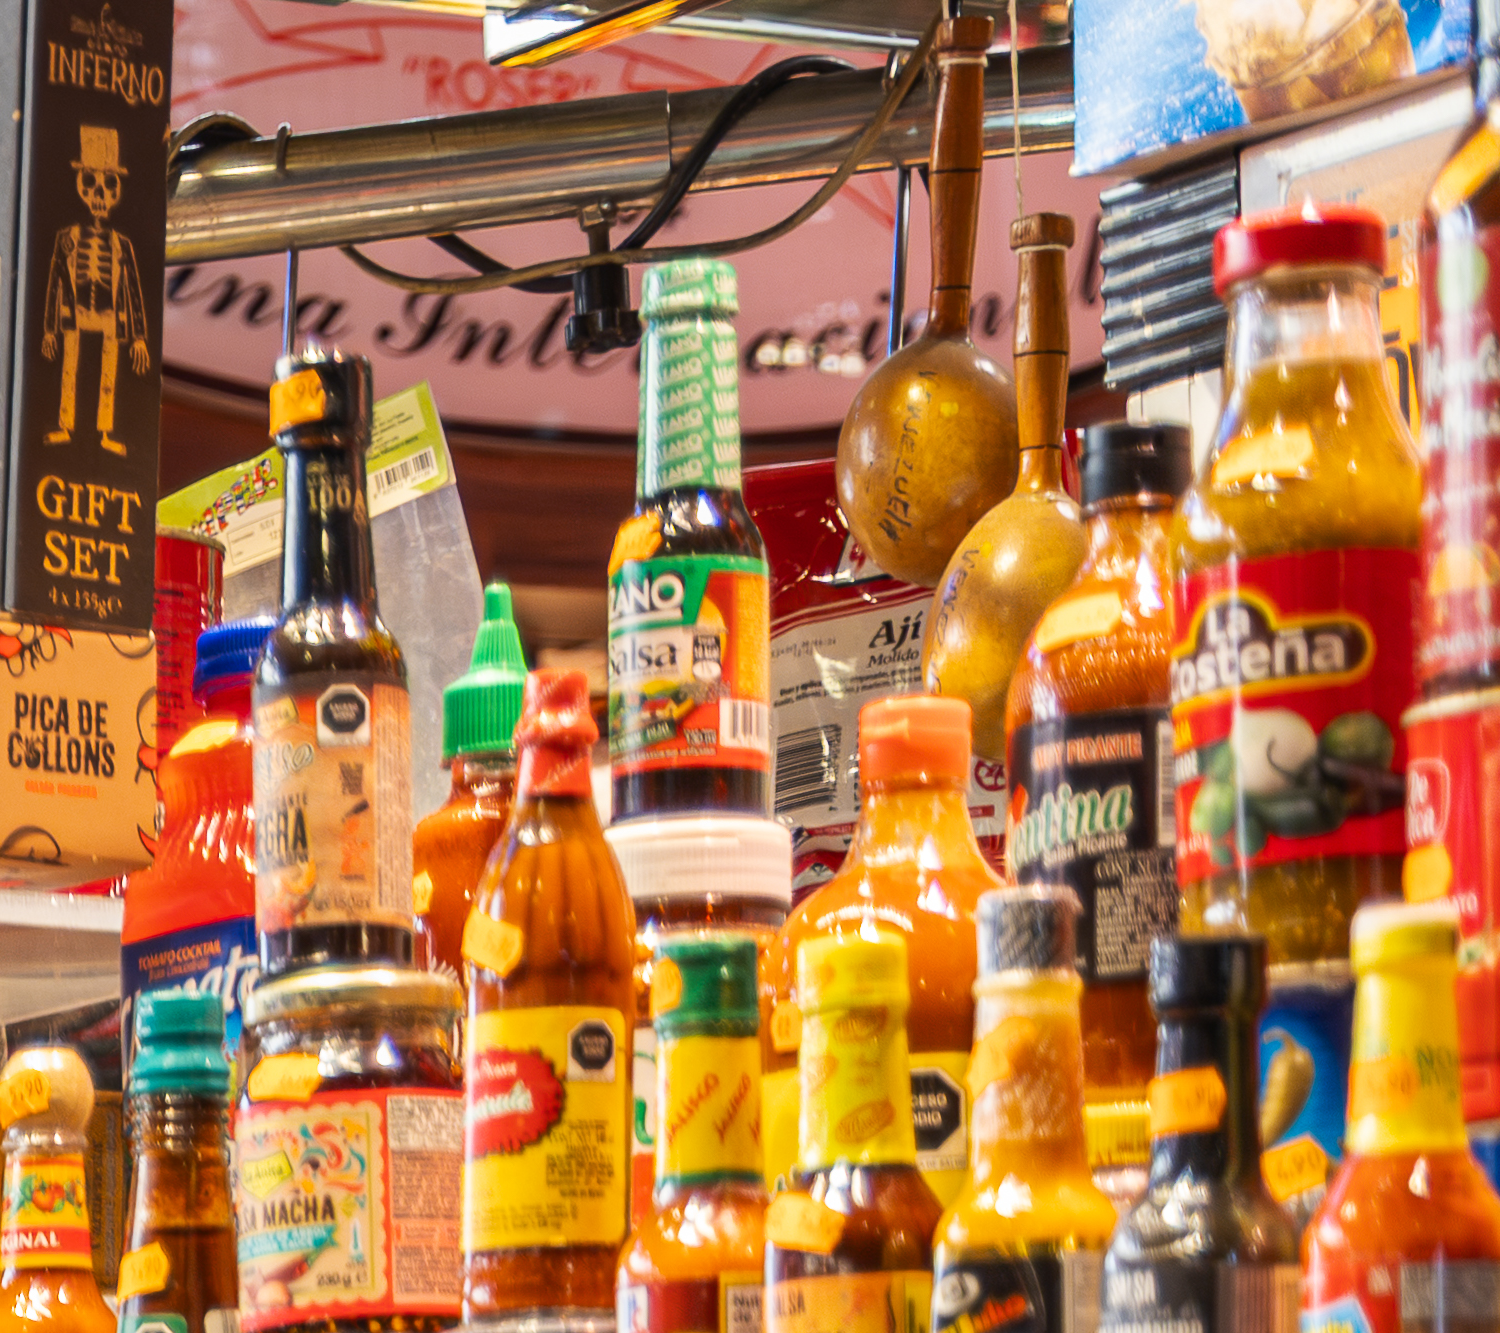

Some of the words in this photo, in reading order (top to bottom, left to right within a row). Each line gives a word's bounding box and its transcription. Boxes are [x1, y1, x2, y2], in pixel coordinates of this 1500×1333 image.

[47, 41, 164, 106] INFERNO
[36, 475, 142, 533] GIFT
[44, 533, 129, 586] SET
[869, 611, 924, 653] Ají
[1207, 605, 1250, 645] La
[867, 649, 920, 669] Molido
[15, 692, 67, 734] PICA
[77, 701, 109, 739] DE
[1066, 732, 1143, 762] PICANTE
[263, 1195, 336, 1226] MACHA
[1, 1231, 60, 1252] GINAL
